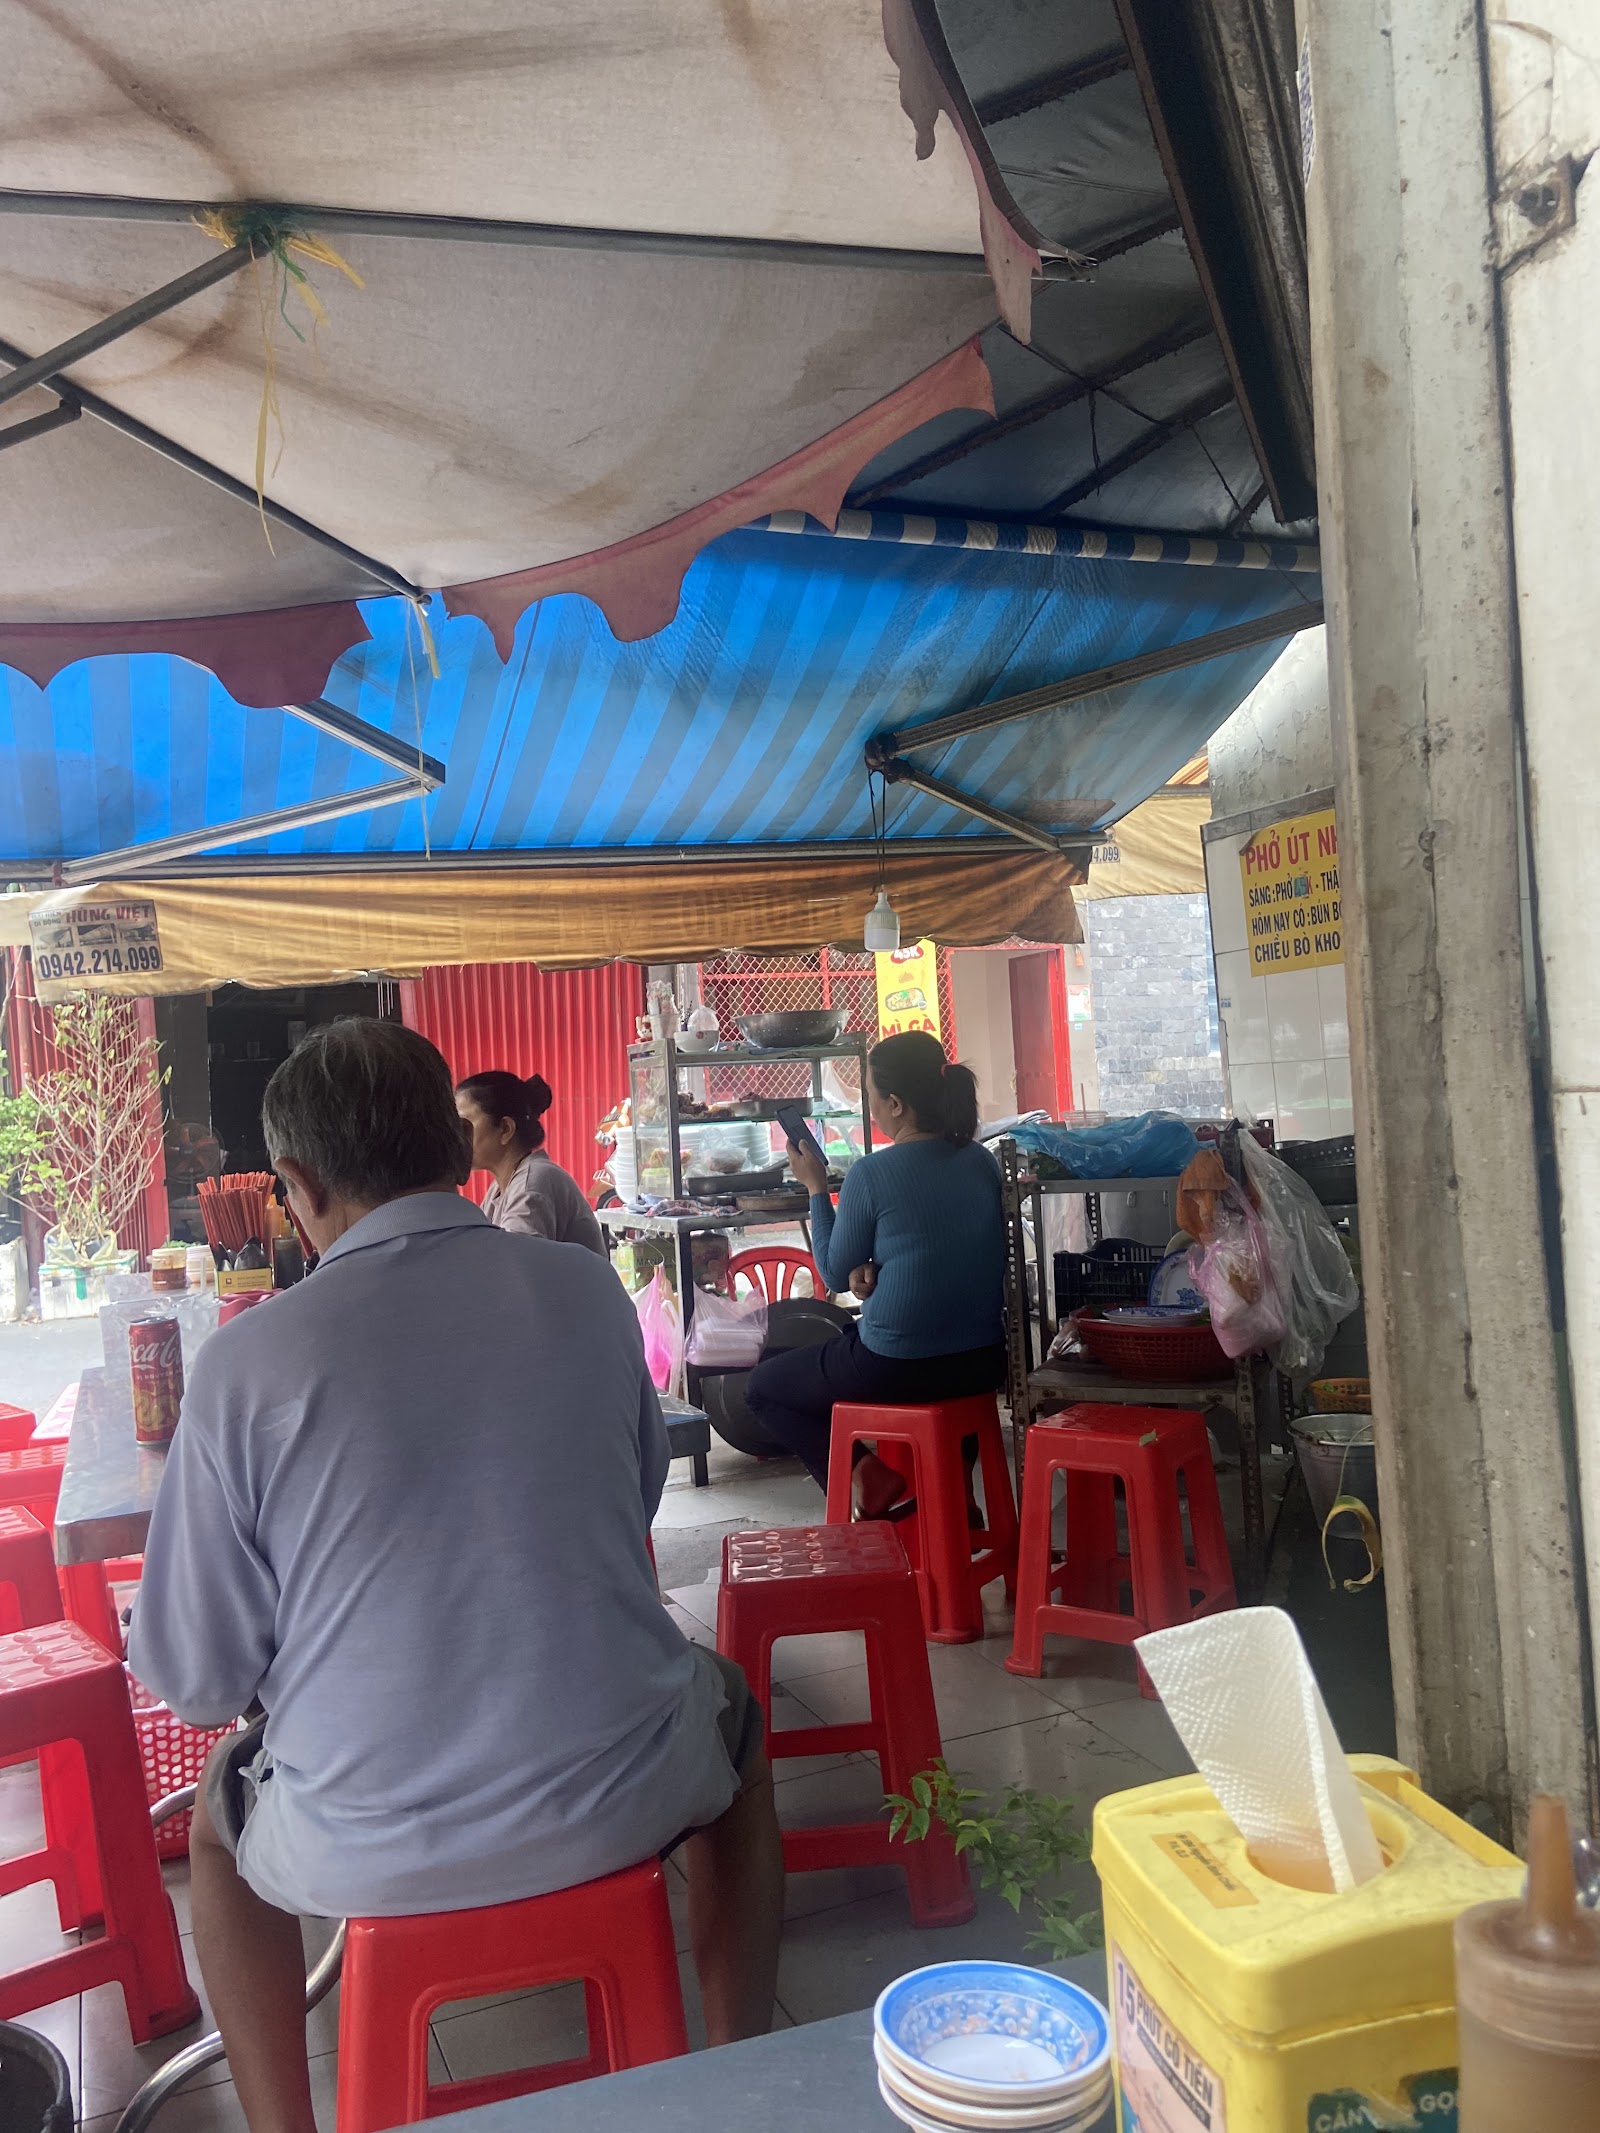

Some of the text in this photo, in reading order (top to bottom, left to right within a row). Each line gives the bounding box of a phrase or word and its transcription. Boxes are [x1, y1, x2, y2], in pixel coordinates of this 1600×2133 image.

[1245, 829, 1281, 875] PHỞ
[1286, 827, 1310, 866] ÚT
[115, 903, 151, 922] VIỆT
[1252, 912, 1272, 936] HÔM
[1273, 910, 1290, 932] NAY
[893, 946, 921, 960] 45K
[1254, 930, 1341, 963] CHIỀU BÒ KHO
[39, 945, 161, 979] 0942.214.099
[881, 1013, 937, 1039] MÌ GÀ
[1117, 1961, 1136, 2026] 15
